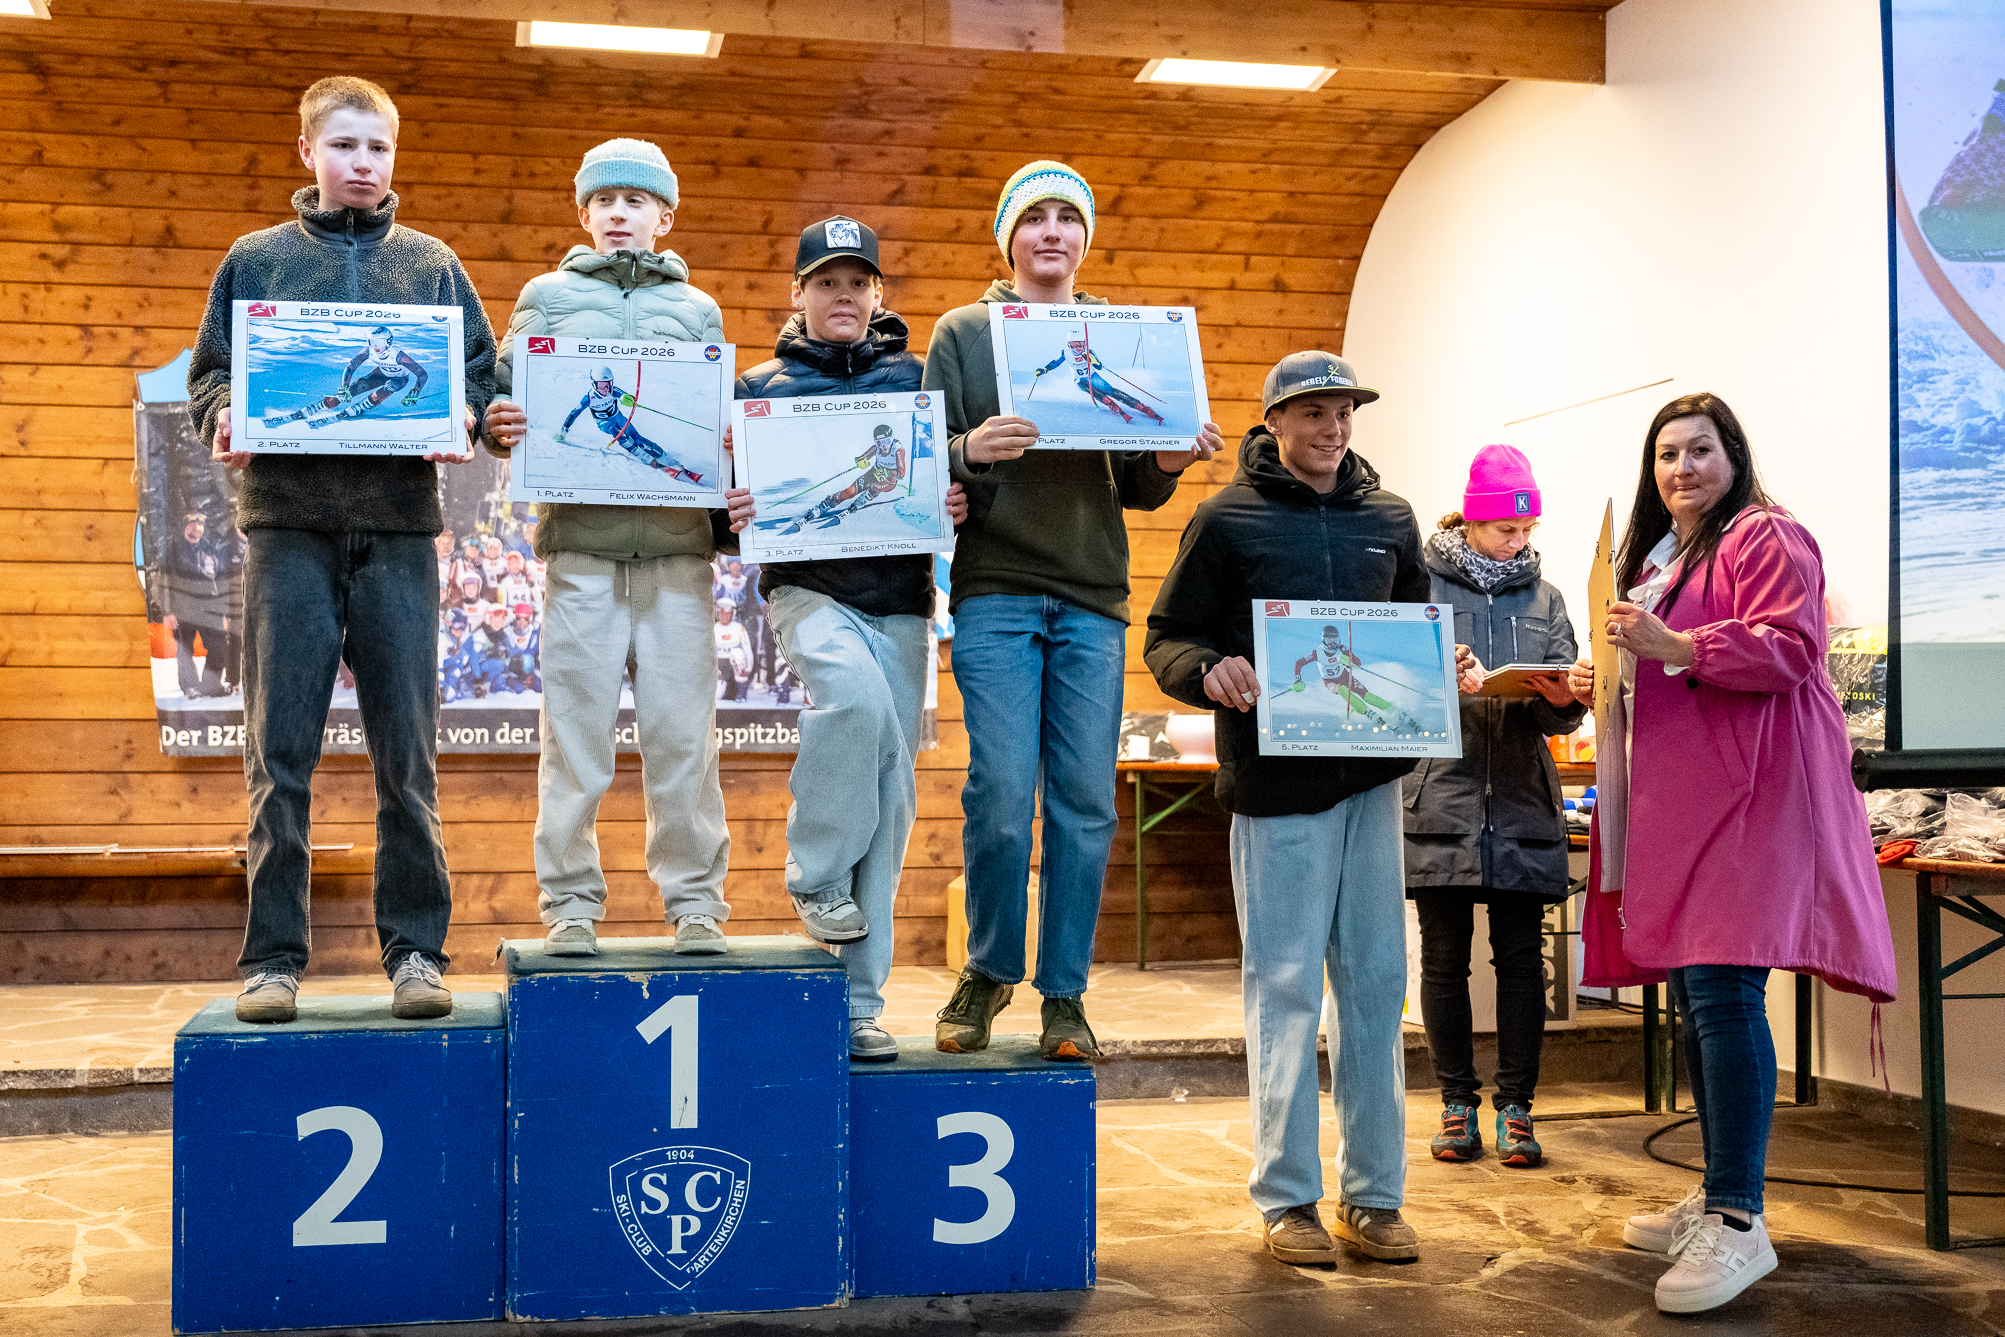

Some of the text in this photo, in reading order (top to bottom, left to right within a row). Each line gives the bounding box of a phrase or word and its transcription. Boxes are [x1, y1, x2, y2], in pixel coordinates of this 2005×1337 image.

[300, 308, 401, 319] BZB CUP 2026
[1049, 310, 1140, 320] BZB CUP 2026
[578, 344, 676, 357] BZB CUP 2026
[792, 400, 887, 413] BZB CUP 2026
[1138, 438, 1181, 446] STAUNER
[544, 490, 574, 498] PLATZ
[609, 492, 697, 502] FELIX WACHSMANN
[1518, 497, 1527, 510] K
[841, 542, 917, 553] BENEDIKT KNOLL
[764, 549, 804, 558] 3. PLATZ
[1310, 607, 1399, 617] BZB CUP 2026
[160, 725, 202, 747] Der
[446, 727, 490, 745] von
[495, 722, 535, 745] der
[715, 722, 800, 750] gspitzba
[1281, 743, 1319, 751] 5. PLATZ
[1350, 744, 1400, 752] MAXIMILIAN
[635, 994, 699, 1129] 1
[665, 1149, 695, 1161] 1904
[292, 1105, 388, 1247] 2
[932, 1111, 1017, 1245] 3
[640, 1170, 722, 1215] S C
[666, 1214, 702, 1255] P
